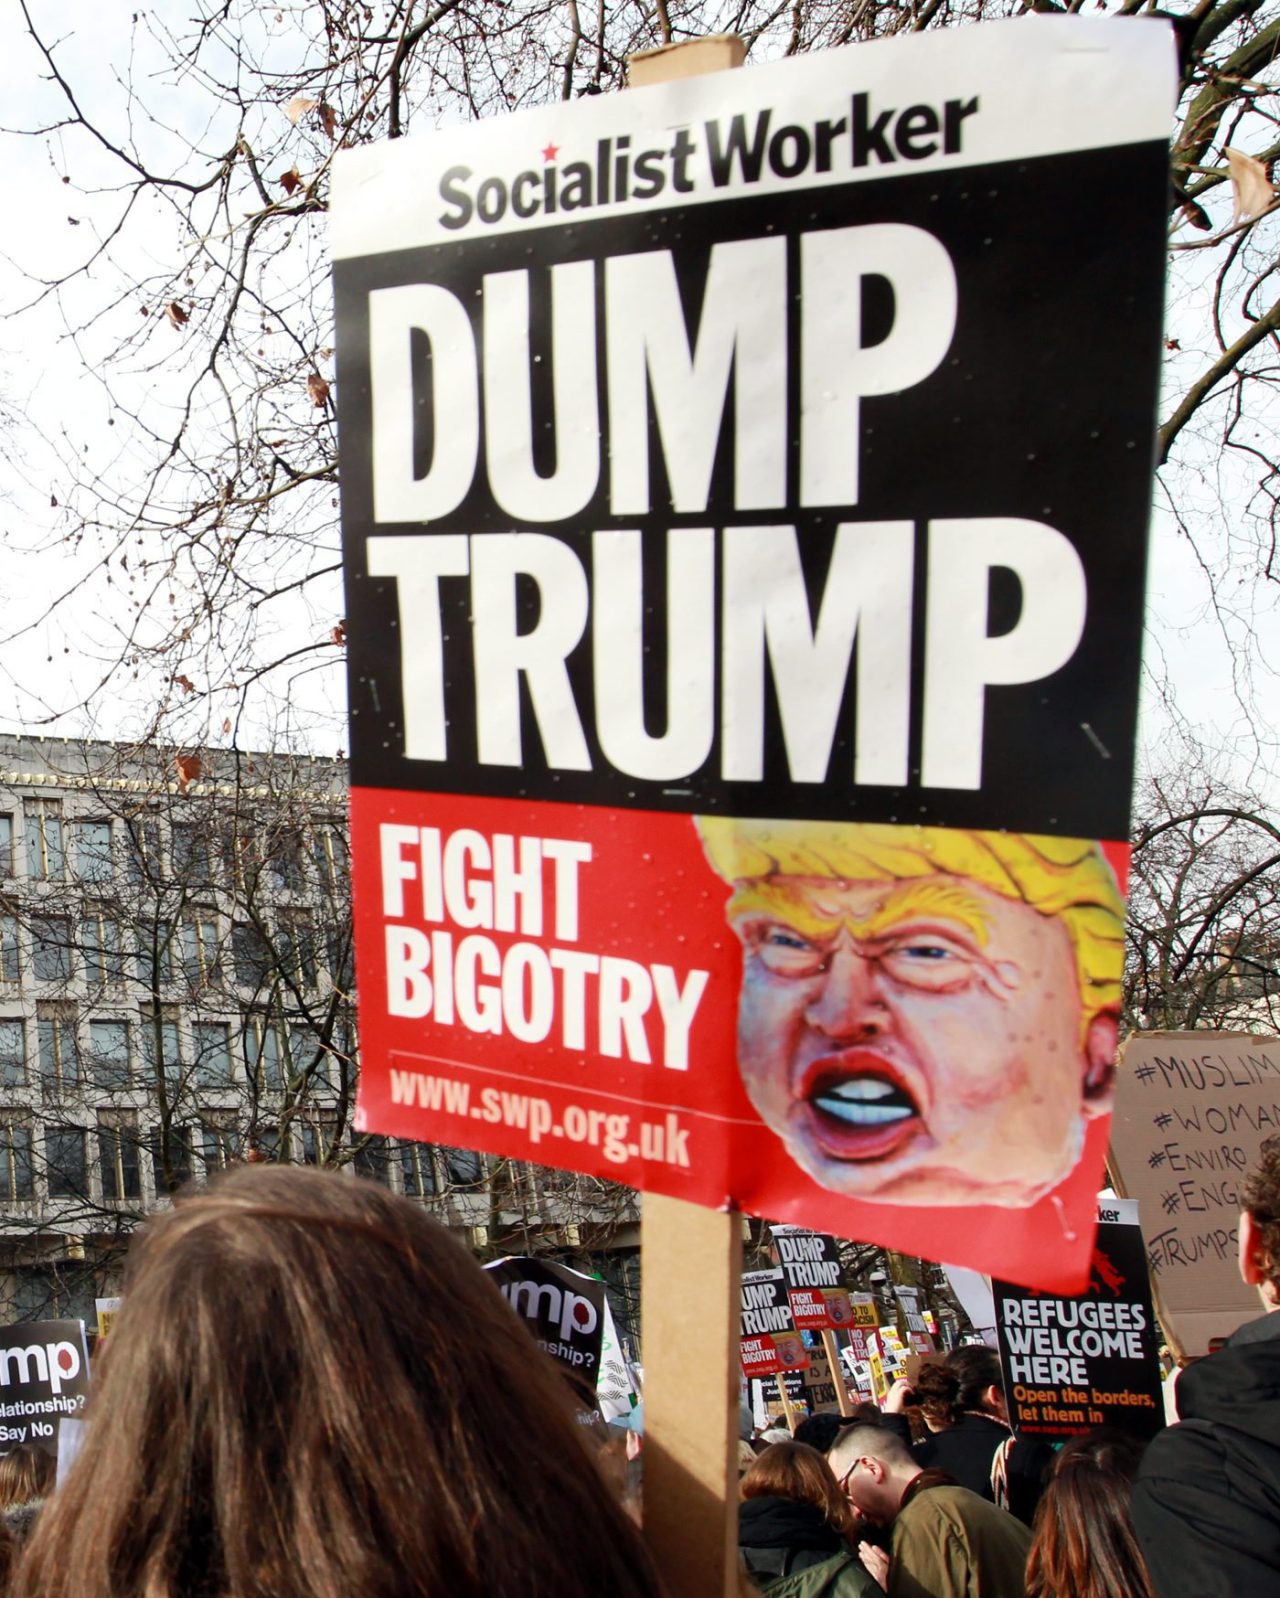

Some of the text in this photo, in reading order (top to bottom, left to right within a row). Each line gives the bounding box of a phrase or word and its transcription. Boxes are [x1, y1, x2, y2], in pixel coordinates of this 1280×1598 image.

[438, 91, 981, 230] Socialist Worker
[368, 223, 958, 523] DUMP
[366, 517, 1088, 790] TRUMP
[379, 823, 592, 942] FIGHT
[385, 924, 710, 1071] BIGOTRY
[390, 1069, 690, 1167] www.swp.org.uk
[778, 1238, 825, 1262] DUMP
[784, 1262, 840, 1287] TRUMP
[741, 1284, 776, 1310] UMP
[791, 1293, 813, 1305] FIGHT
[793, 1304, 826, 1316] BIGOTRY
[1002, 1298, 1146, 1331] REFUGEES
[850, 1328, 863, 1339] NO
[853, 1339, 864, 1349] TO
[1004, 1327, 1145, 1360] WELCOME
[740, 1340, 762, 1353] FIGHT
[742, 1349, 776, 1364] BIGOTRY
[1009, 1355, 1089, 1386] HERE
[1013, 1385, 1155, 1408] Open the borders,
[1018, 1404, 1103, 1423] let them in
[31, 1422, 53, 1438] No
